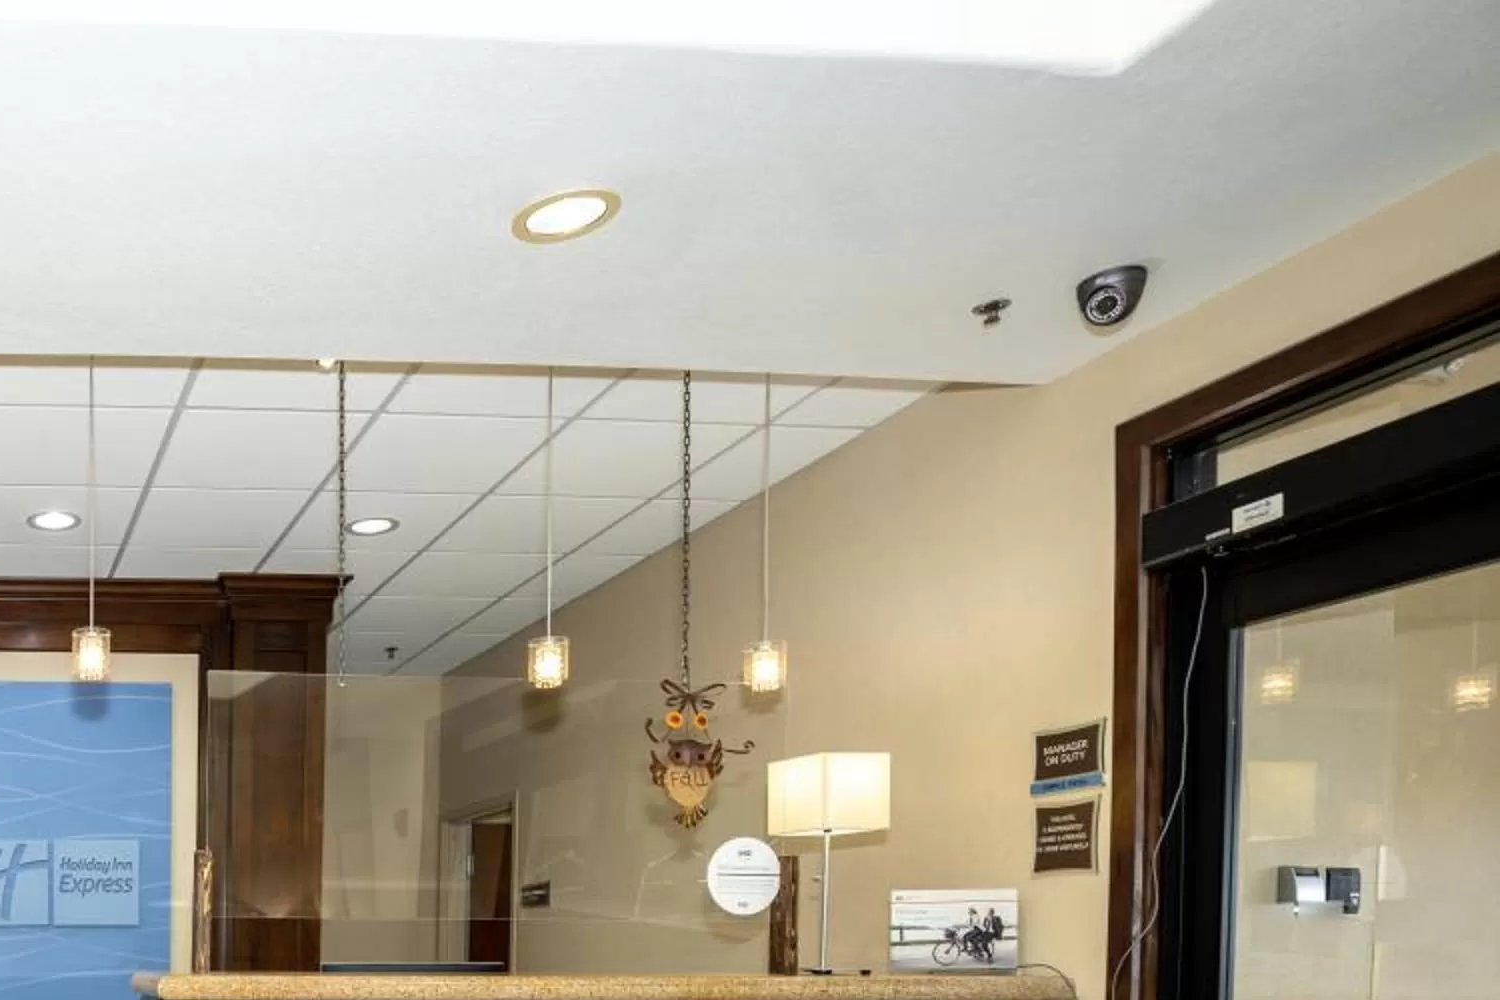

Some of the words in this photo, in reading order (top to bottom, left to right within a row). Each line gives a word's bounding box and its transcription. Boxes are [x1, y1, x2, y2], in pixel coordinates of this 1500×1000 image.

[1043, 739, 1089, 756] MANAGER
[1045, 755, 1059, 767] ON
[1060, 750, 1086, 764] DUTY
[60, 856, 111, 874] Holiday
[111, 857, 133, 871] Inn
[59, 874, 133, 897] Express
